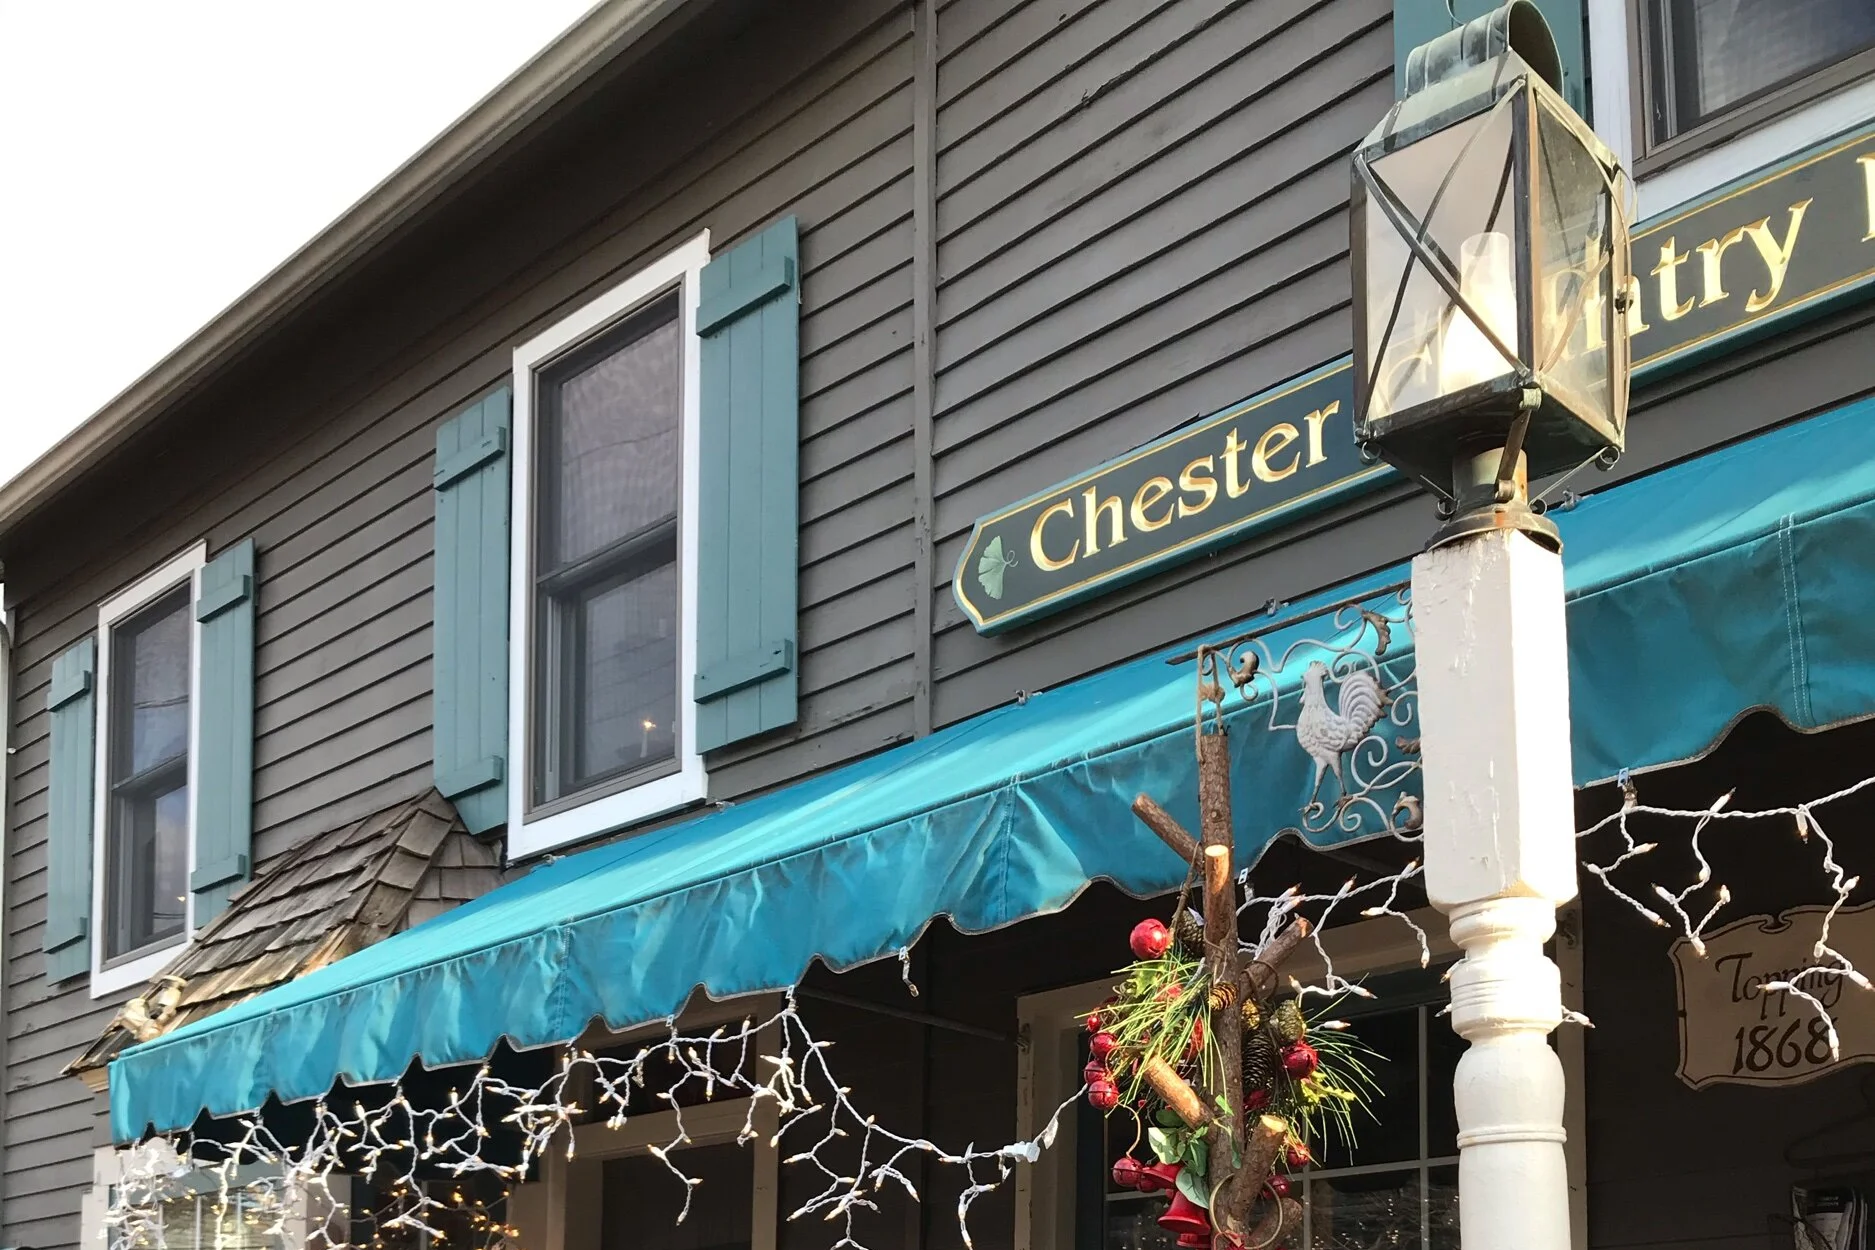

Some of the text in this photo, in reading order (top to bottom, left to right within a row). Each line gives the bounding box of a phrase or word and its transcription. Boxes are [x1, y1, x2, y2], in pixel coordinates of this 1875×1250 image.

[1030, 398, 1341, 573] Chester
[1714, 951, 1844, 1021] Topping
[1732, 1016, 1838, 1075] 1868
